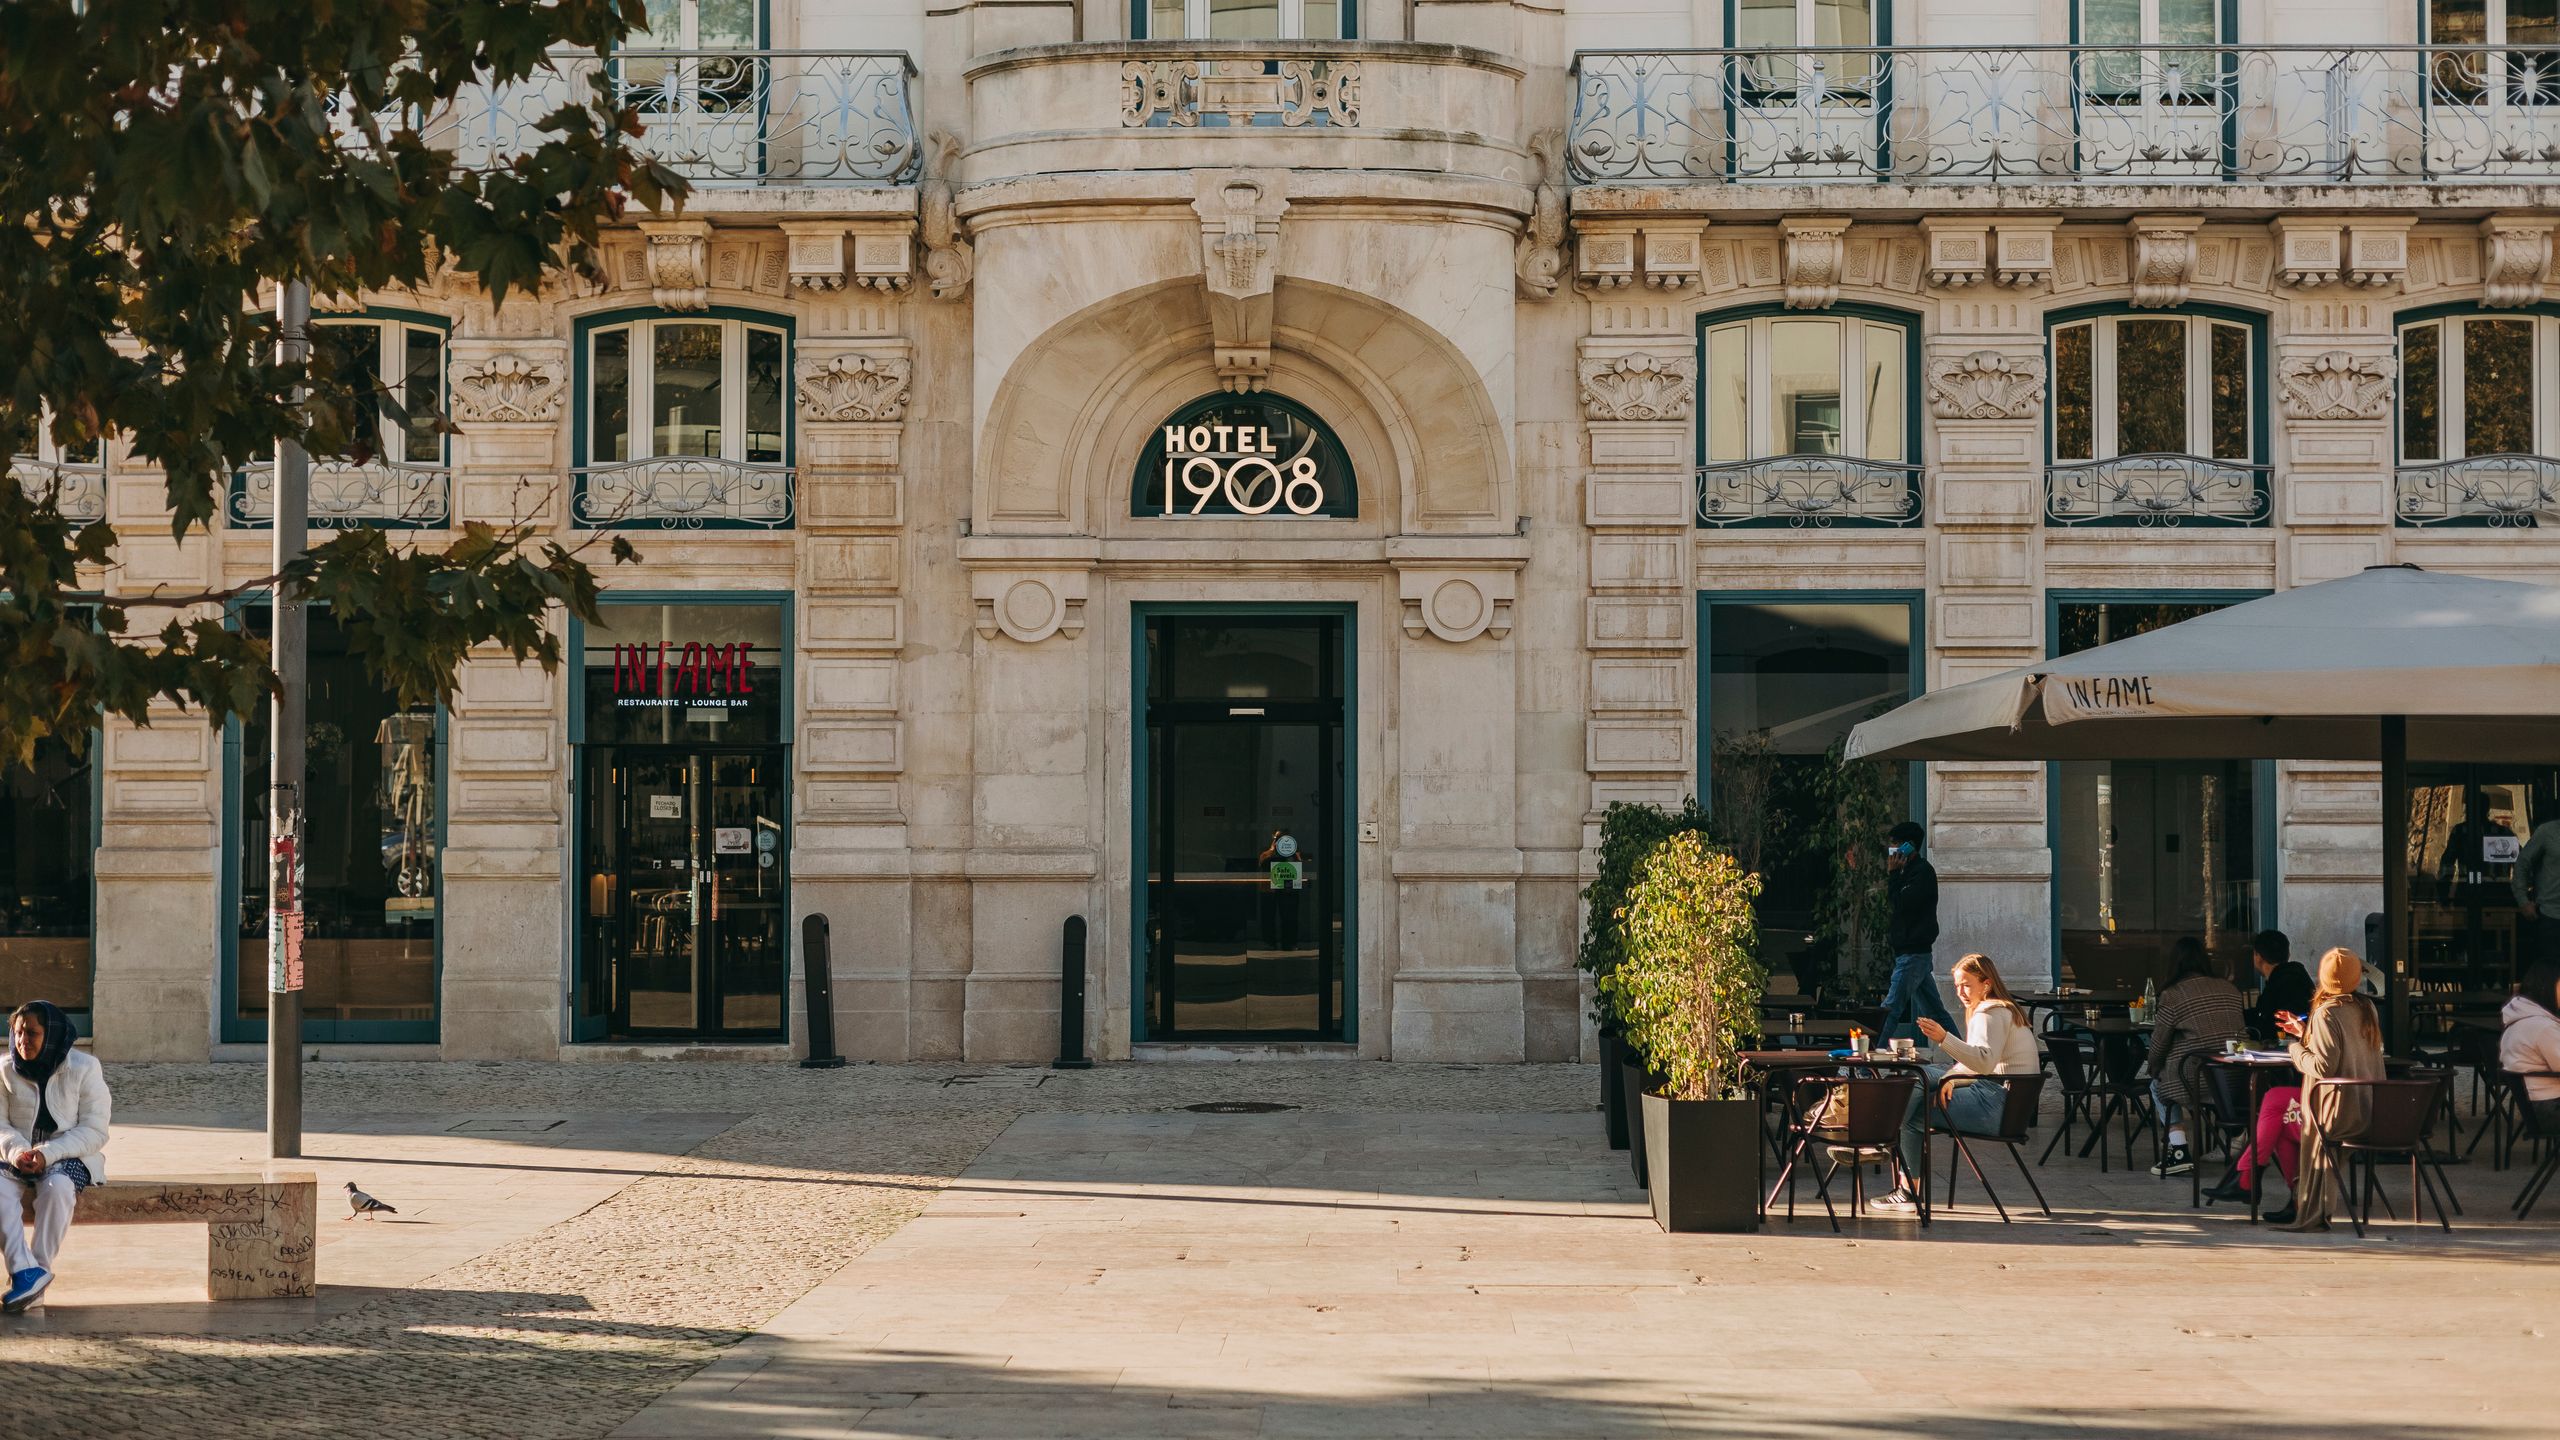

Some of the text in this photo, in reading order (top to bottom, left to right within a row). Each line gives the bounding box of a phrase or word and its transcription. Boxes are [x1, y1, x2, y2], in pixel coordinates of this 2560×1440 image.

[1165, 425, 1277, 453] HOTEL
[1165, 456, 1324, 515] 1908
[613, 641, 756, 697] INFAME
[617, 699, 748, 707] RESTAURANTE LOUNGE BAR
[2066, 676, 2155, 709] INFAME
